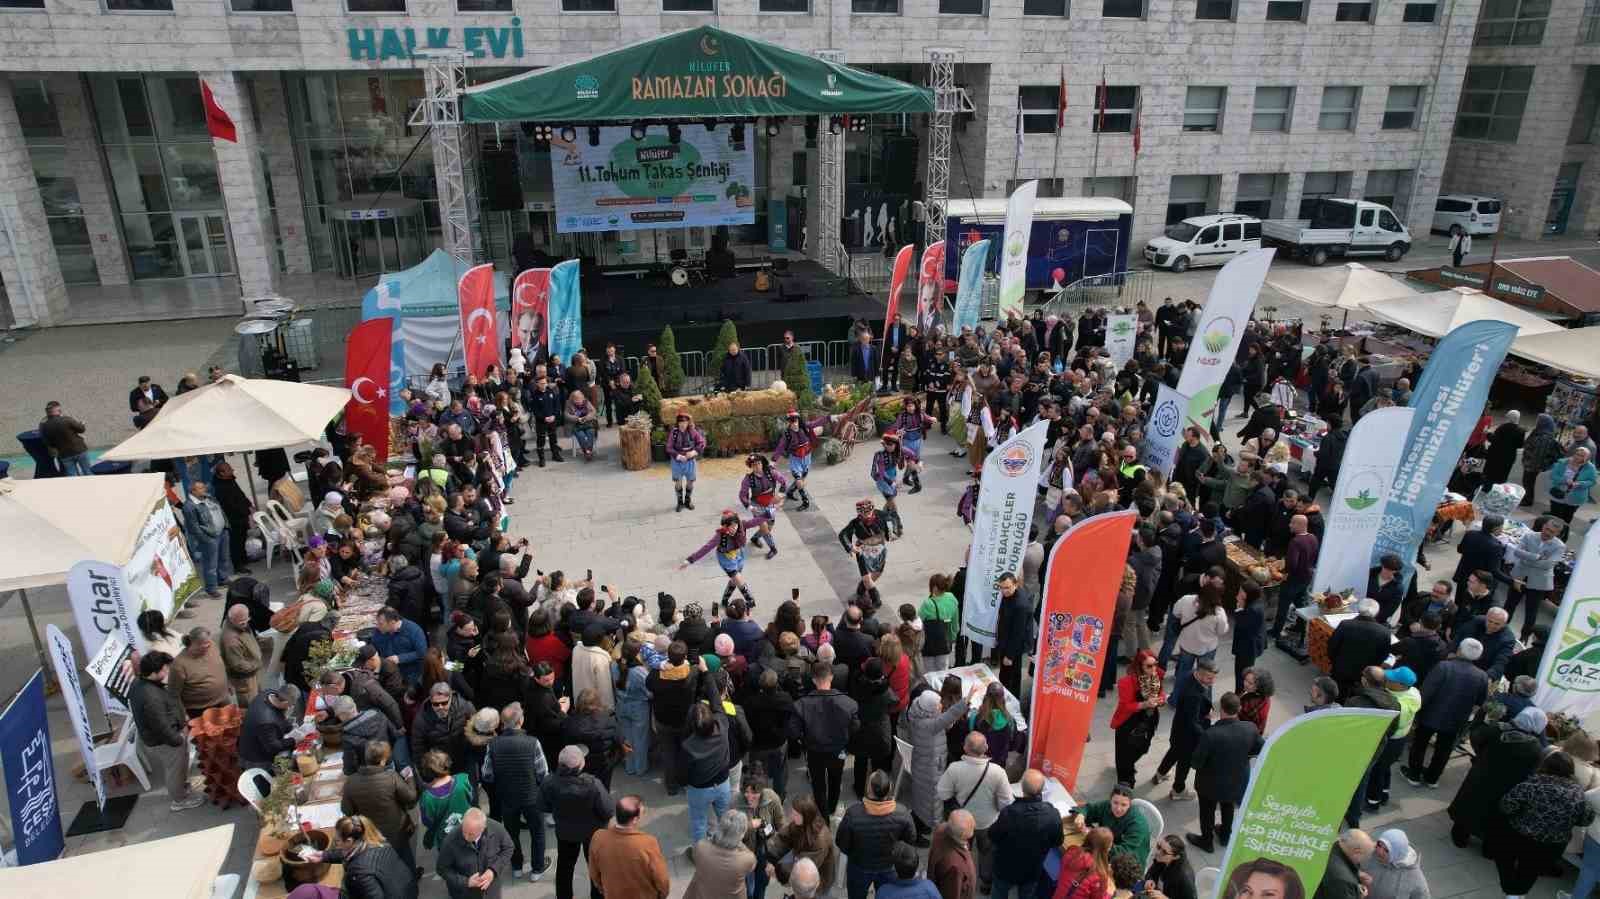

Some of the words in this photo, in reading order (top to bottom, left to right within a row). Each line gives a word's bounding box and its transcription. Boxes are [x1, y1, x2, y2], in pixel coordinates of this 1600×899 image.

[346, 27, 449, 60] HALK
[463, 16, 524, 59] EVİ
[631, 75, 717, 100] RAMAZAN
[722, 71, 787, 98] SOKAĞI
[642, 162, 682, 179] Takas
[1389, 425, 1431, 503] Herkesin
[1427, 385, 1450, 422] sesi
[1401, 419, 1451, 507] Hepimizin
[1443, 343, 1490, 416] Nilüfer'i
[999, 491, 1016, 556] BAHÇELER
[995, 556, 1007, 574] VE
[87, 569, 121, 635] Char
[1267, 828, 1330, 852] BİRLİKTE
